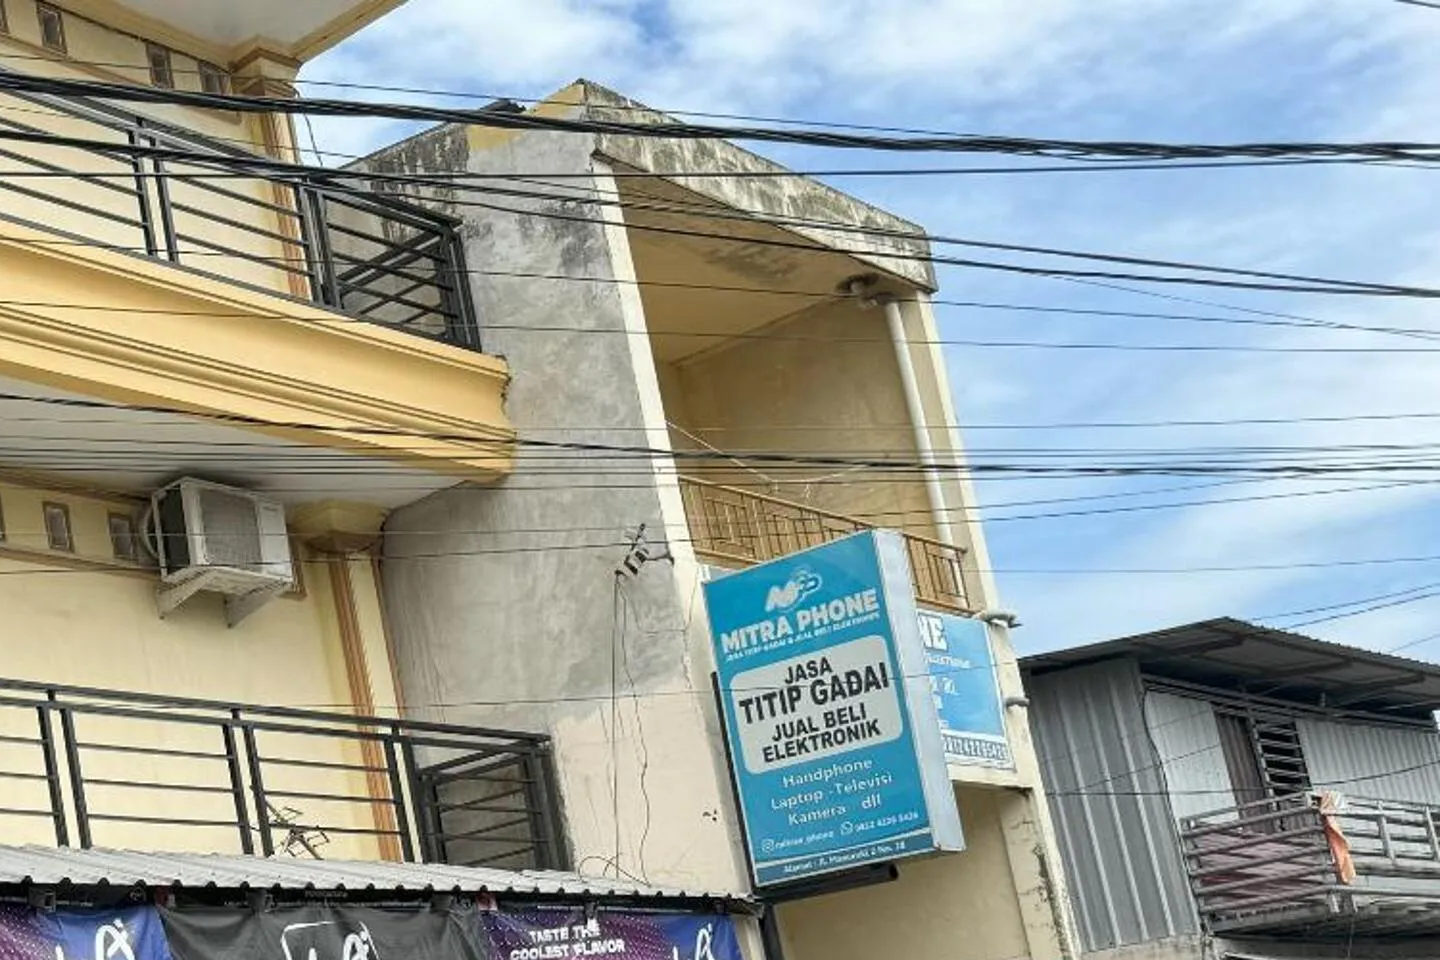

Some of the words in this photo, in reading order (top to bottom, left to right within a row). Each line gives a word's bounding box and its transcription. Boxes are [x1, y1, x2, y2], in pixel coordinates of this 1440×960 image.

[721, 616, 794, 653] MITRA
[796, 588, 880, 631] PHONE
[784, 656, 833, 684] JASA
[739, 685, 802, 724] TITIP
[810, 662, 890, 706] GADAI
[771, 716, 820, 742] JUAL
[823, 702, 867, 728] BELI
[762, 719, 881, 763] ELEKTRONIK
[782, 759, 873, 788] Handphone
[771, 790, 824, 810] Laptop
[788, 805, 847, 826] Kamera
[861, 793, 882, 810] dll
[528, 926, 569, 943] TASTE
[572, 918, 600, 939] THE
[572, 938, 625, 956] FLAVOR
